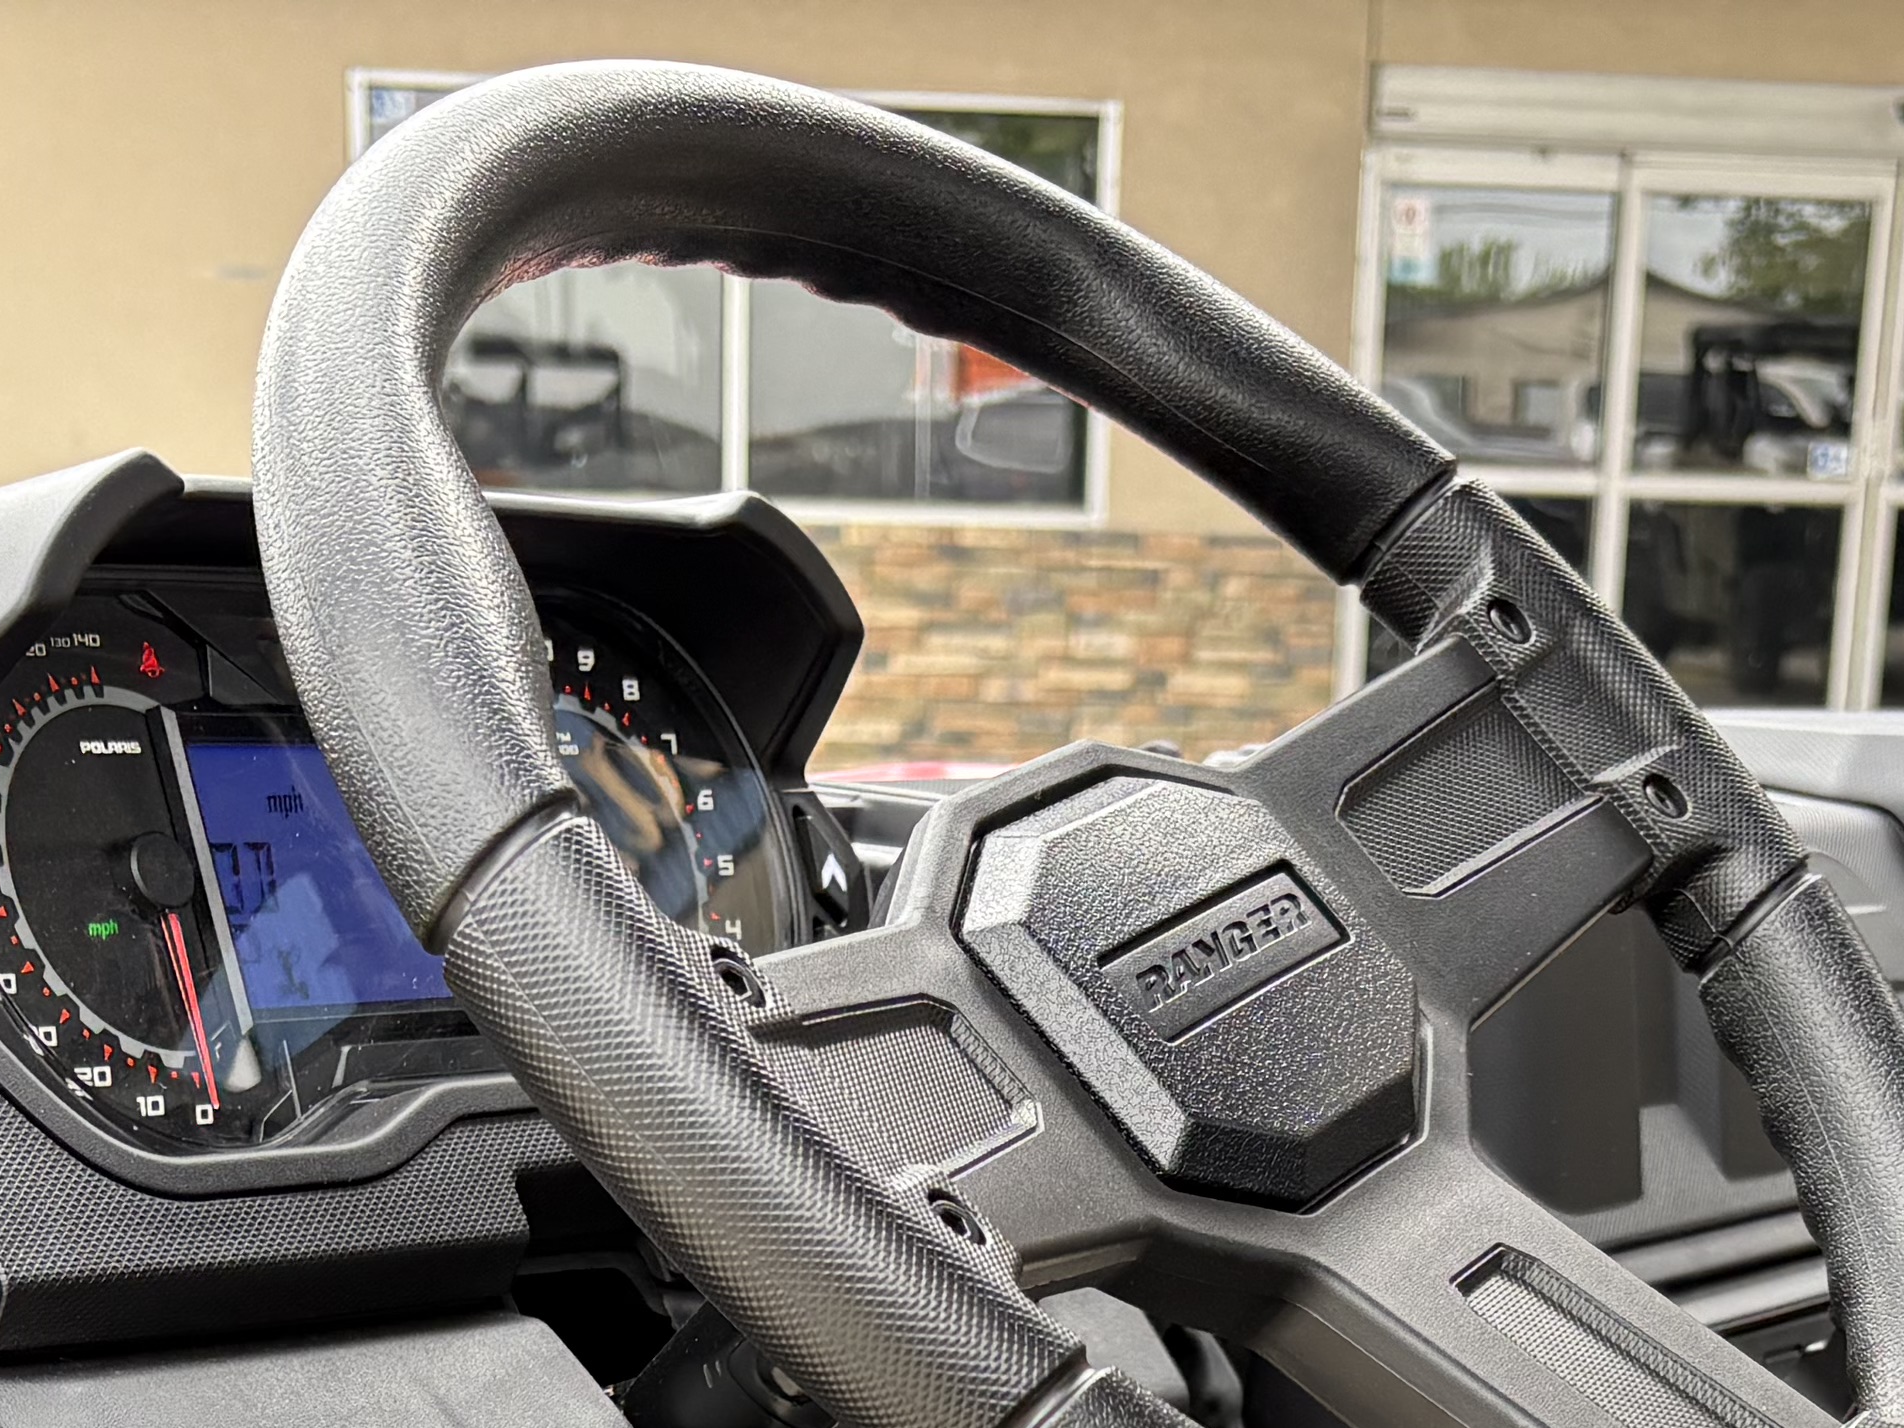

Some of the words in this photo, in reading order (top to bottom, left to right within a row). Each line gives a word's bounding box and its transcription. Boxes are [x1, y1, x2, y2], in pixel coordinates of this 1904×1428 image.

[50, 636, 70, 648] 130
[72, 633, 101, 647] 140
[577, 648, 595, 672] 9
[622, 676, 640, 701] 8
[80, 741, 141, 754] POLARIS
[660, 733, 678, 755] 7
[267, 785, 303, 820] mph
[697, 789, 714, 811] 6
[717, 854, 735, 876] 5
[88, 918, 119, 941] mph
[725, 919, 742, 941] 4
[1135, 892, 1312, 1013] RANGER
[136, 1094, 165, 1116] 10
[195, 1104, 214, 1125] 0
